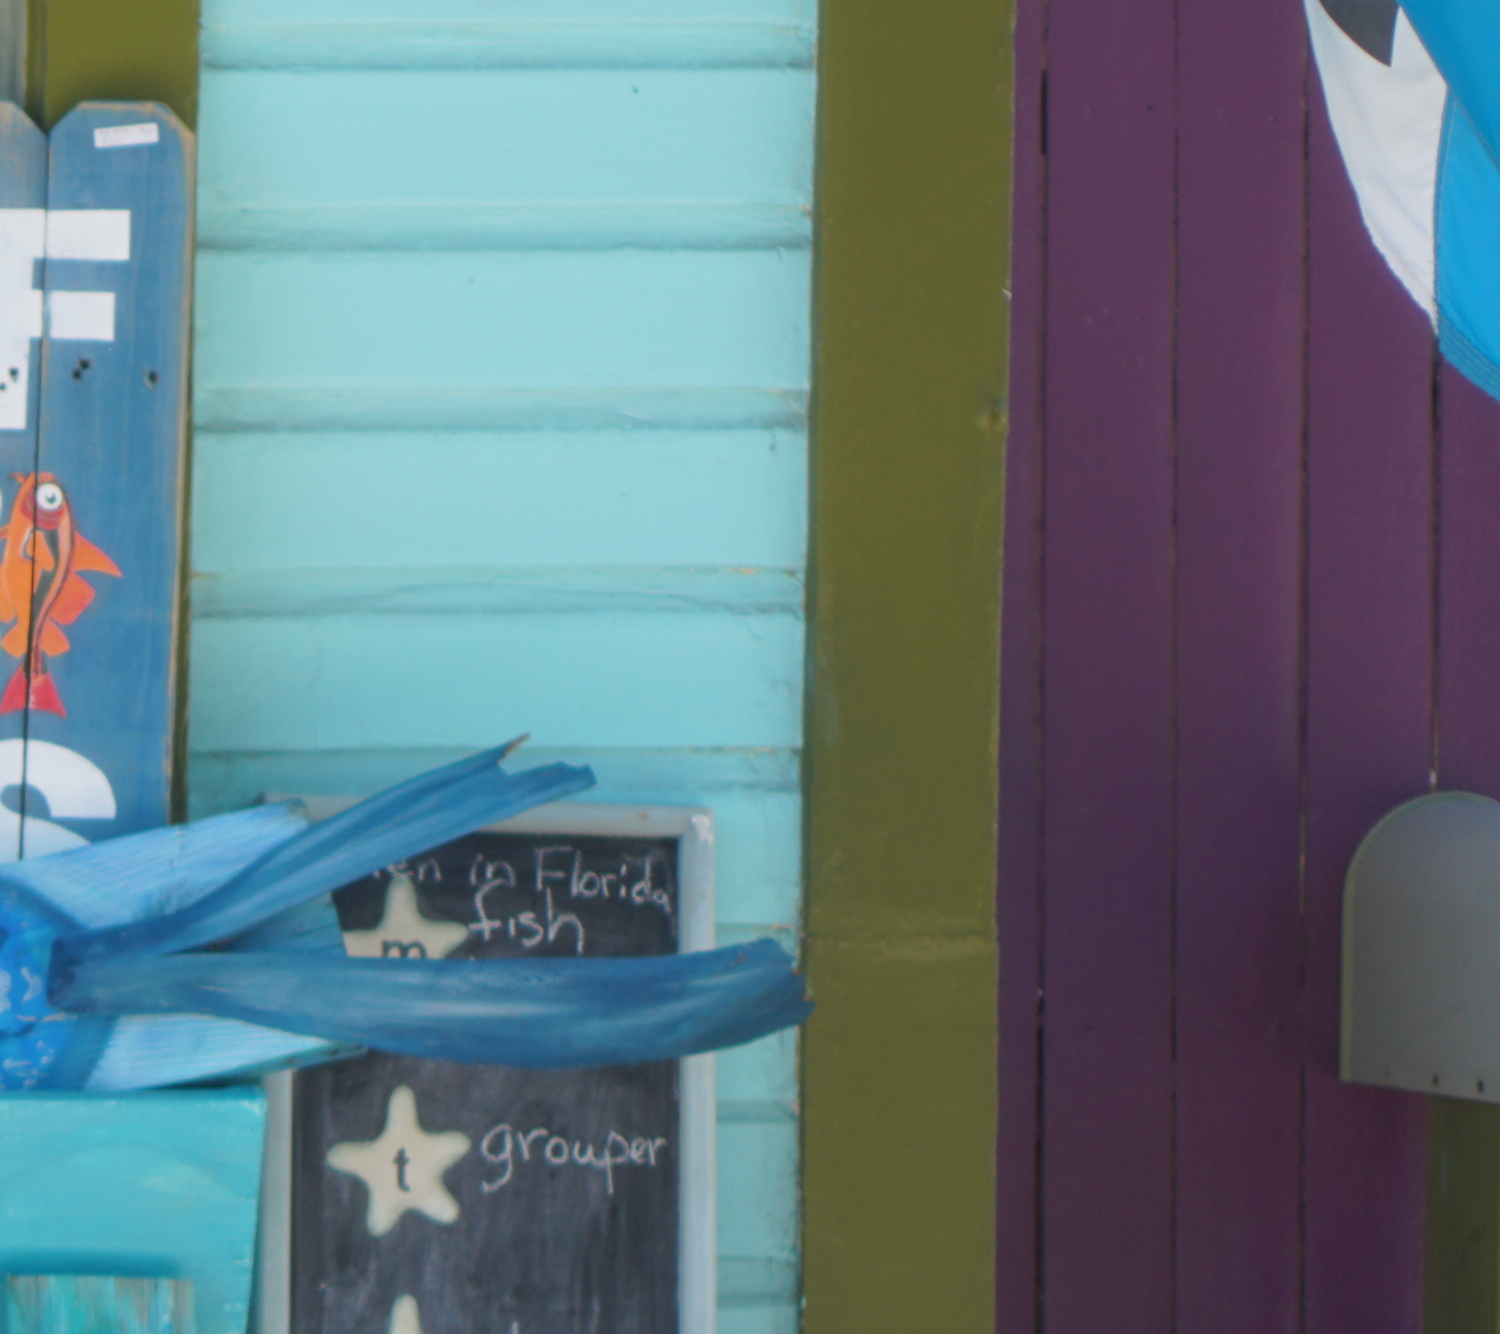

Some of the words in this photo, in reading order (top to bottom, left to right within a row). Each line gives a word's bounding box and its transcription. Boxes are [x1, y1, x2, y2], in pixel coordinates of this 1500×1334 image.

[470, 854, 516, 886] in
[535, 845, 674, 915] Florida
[468, 878, 585, 956] fish
[393, 1147, 411, 1192] t
[480, 1123, 668, 1195] grouper
